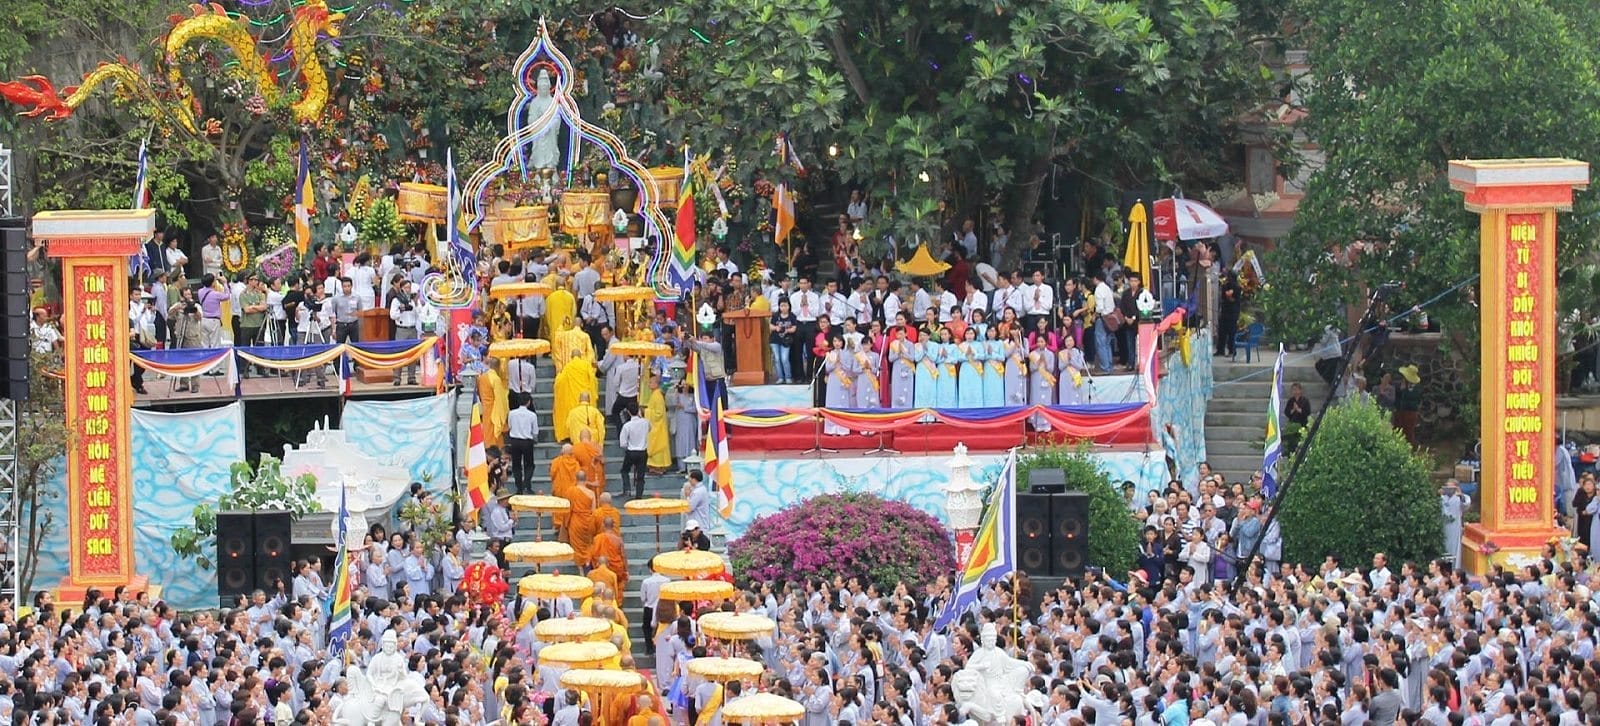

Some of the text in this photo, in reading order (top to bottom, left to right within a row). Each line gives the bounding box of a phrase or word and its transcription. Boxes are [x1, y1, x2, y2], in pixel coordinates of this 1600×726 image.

[1511, 222, 1536, 243] NIỆM
[83, 273, 105, 292] TÂM
[1517, 272, 1528, 288] BI
[86, 295, 102, 315] TRÍ
[87, 395, 108, 414] VẠN
[1506, 390, 1541, 411] NGHIỆP
[88, 440, 109, 459] HÔN
[90, 464, 105, 483] MÊ
[1512, 460, 1534, 480] TIÊU
[1509, 487, 1537, 503] VONG
[87, 538, 111, 557] SẠCH
